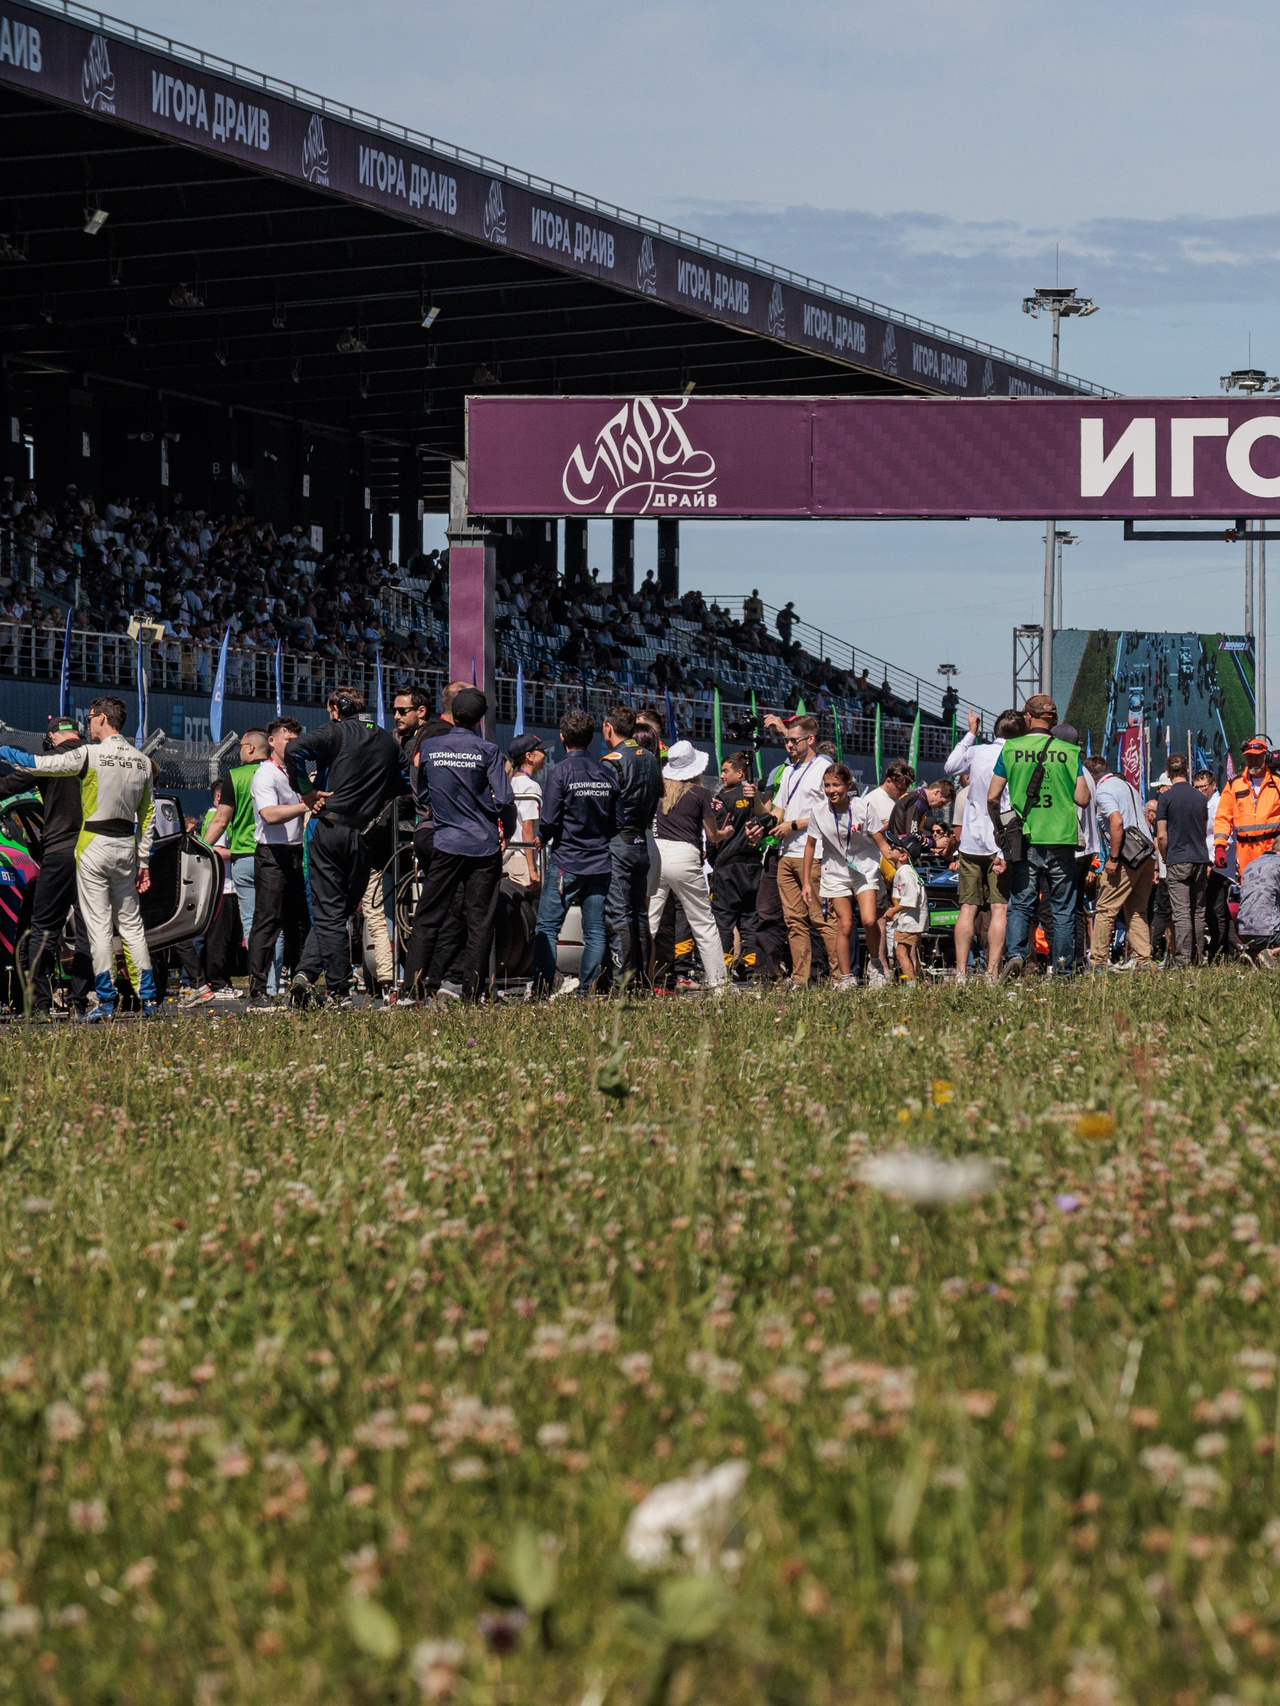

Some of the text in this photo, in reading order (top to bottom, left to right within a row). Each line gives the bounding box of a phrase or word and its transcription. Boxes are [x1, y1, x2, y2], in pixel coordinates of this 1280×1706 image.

[152, 70, 209, 131] ИГОРА
[359, 145, 406, 198] ИГОРА
[531, 207, 571, 254] ИГОРА
[678, 259, 712, 302] ИГОРА
[804, 303, 834, 343] ИГОРА
[912, 342, 939, 378] ИГОРА
[652, 490, 718, 508] ДРАЙВ
[119, 761, 133, 769] 49
[429, 752, 482, 761] ТЕХНИЧЕСКАЯ
[434, 760, 476, 768] КОМИССИЯ
